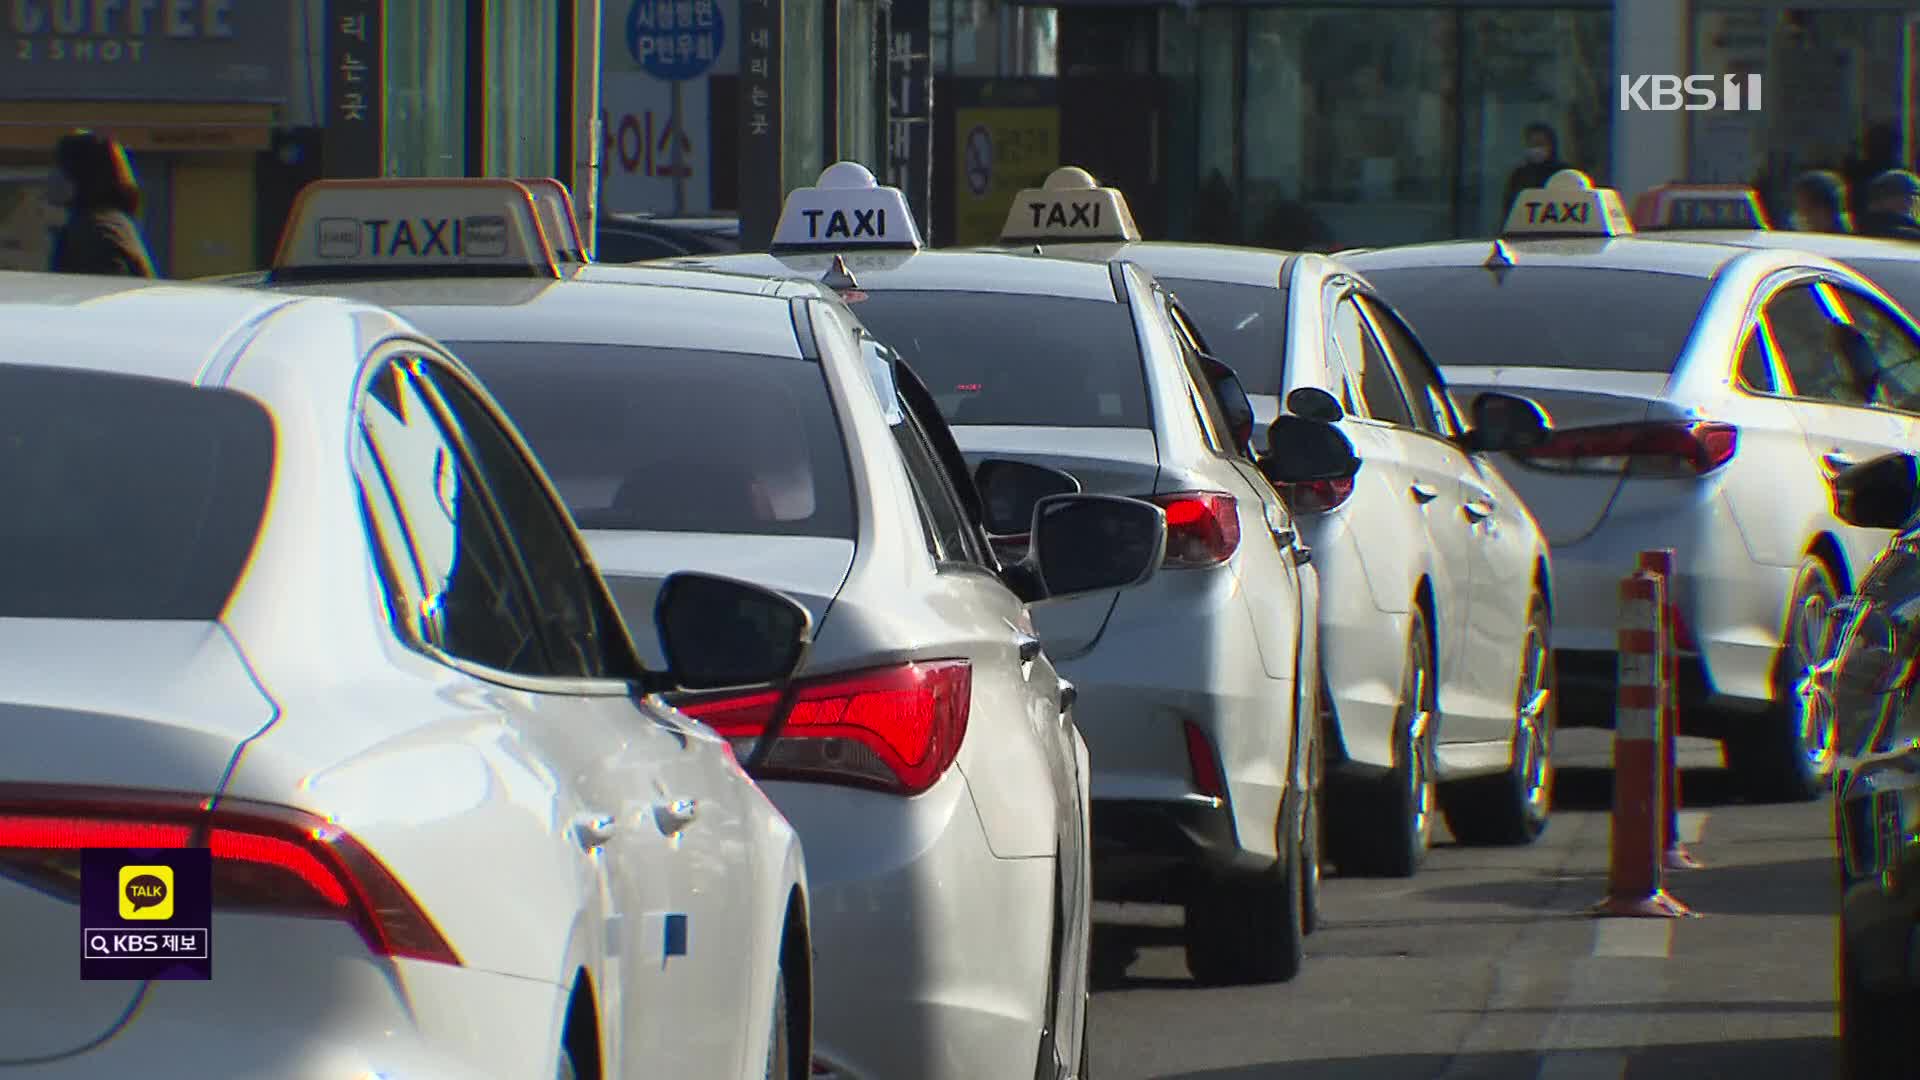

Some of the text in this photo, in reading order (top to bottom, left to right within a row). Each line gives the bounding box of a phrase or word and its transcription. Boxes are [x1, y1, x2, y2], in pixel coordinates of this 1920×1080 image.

[16, 38, 33, 61] 2
[604, 110, 693, 176] 이소
[802, 208, 885, 239] TAXI
[1030, 202, 1100, 228] TAXI
[1524, 201, 1592, 224] TAXI
[363, 219, 463, 257] TAXI
